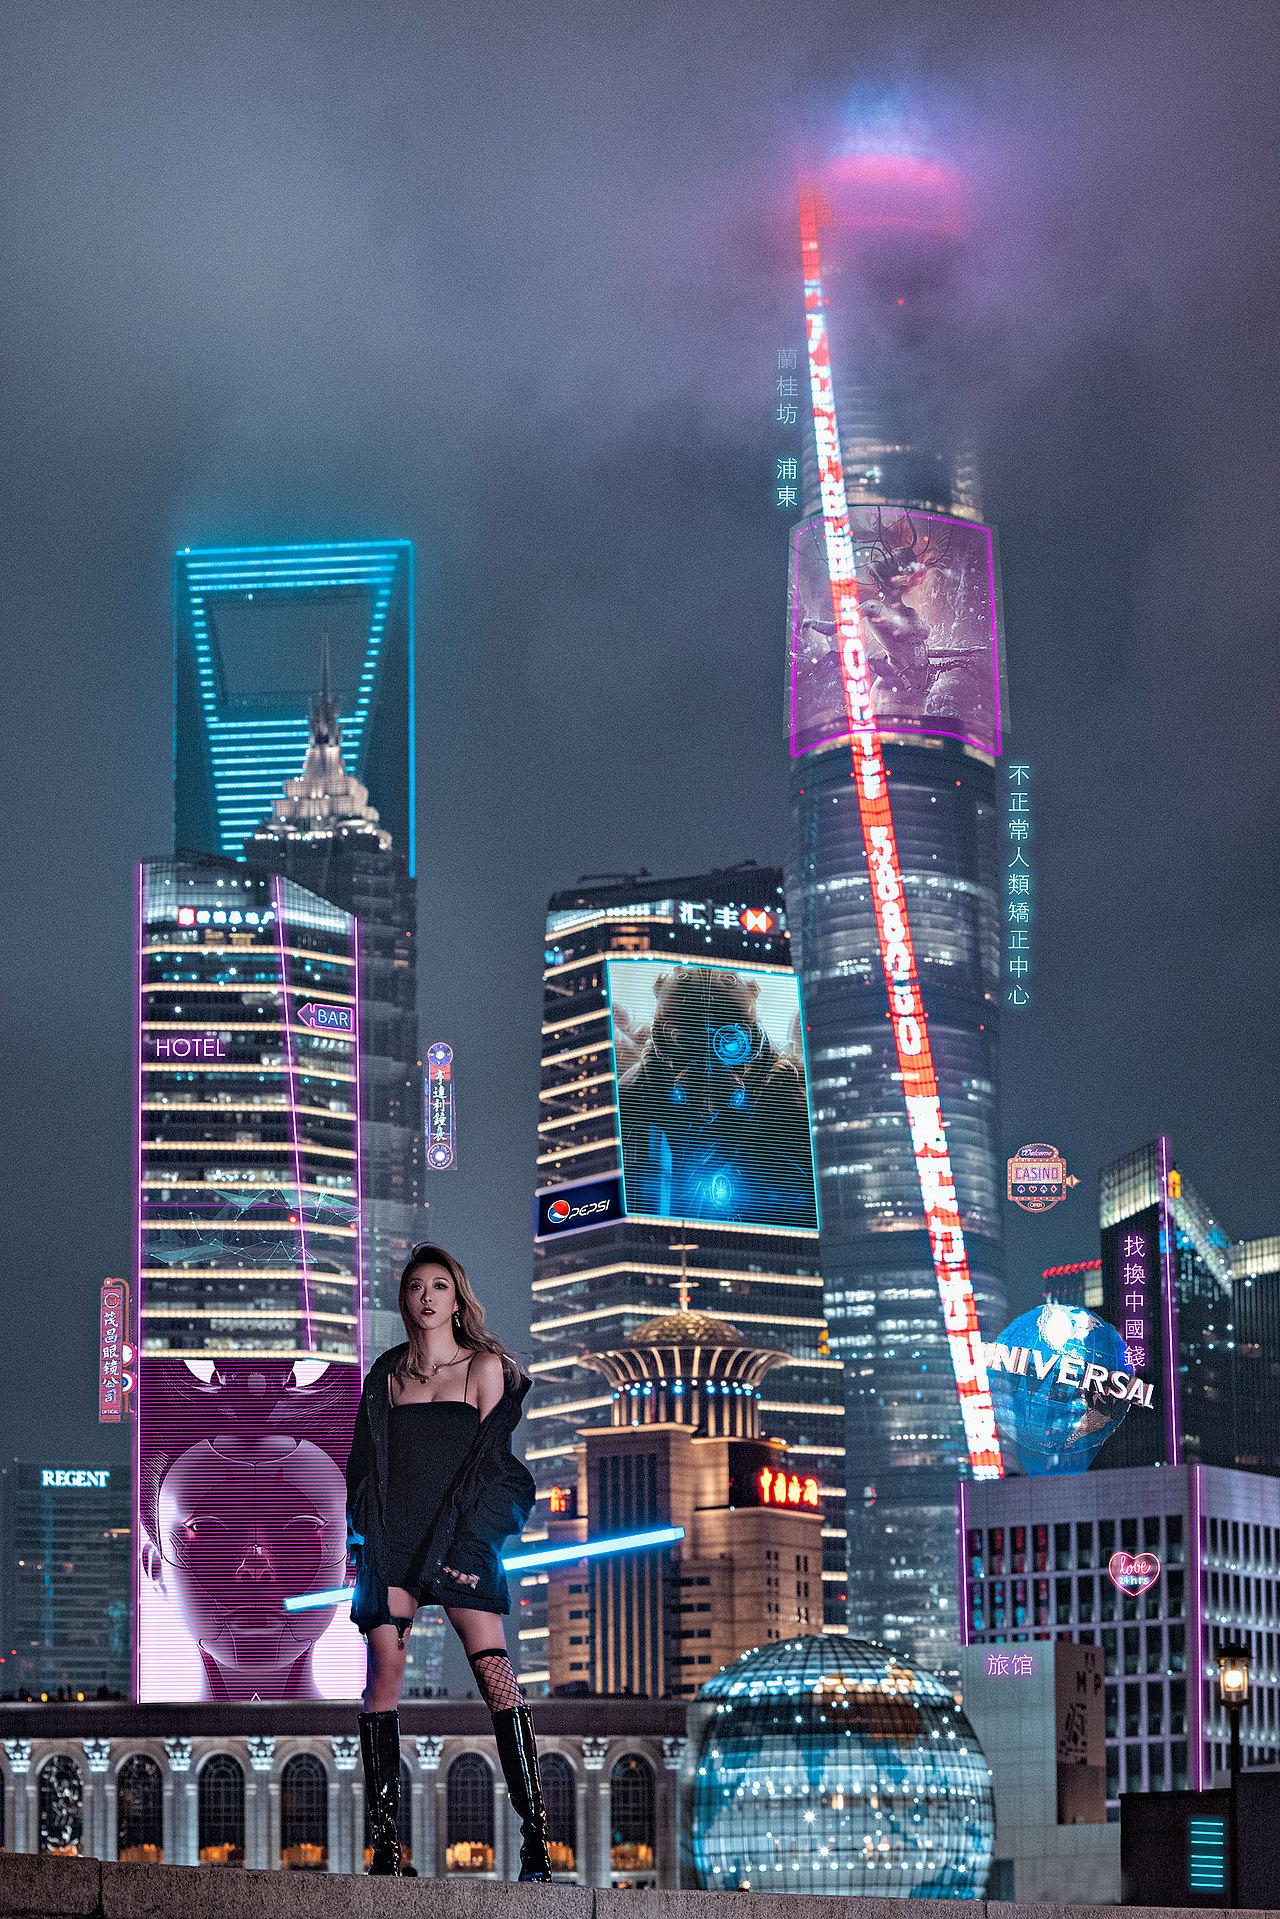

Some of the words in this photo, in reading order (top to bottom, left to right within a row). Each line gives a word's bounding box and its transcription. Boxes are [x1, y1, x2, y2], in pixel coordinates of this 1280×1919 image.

[776, 348, 799, 425] 蘭桂坊
[776, 458, 799, 507] 浦東
[1008, 765, 1031, 1005] 不正常人類矯正中心
[679, 900, 740, 930] 汇丰
[317, 1008, 348, 1027] BAR
[156, 1038, 226, 1057] HOTEL
[1020, 1149, 1053, 1157] Welcome
[1014, 1166, 1060, 1180] CASINO
[1123, 1235, 1146, 1368] 找換中國錢
[41, 1469, 110, 1488] REGENT
[1120, 1555, 1151, 1575] love
[987, 1653, 1034, 1676] 旅馆
